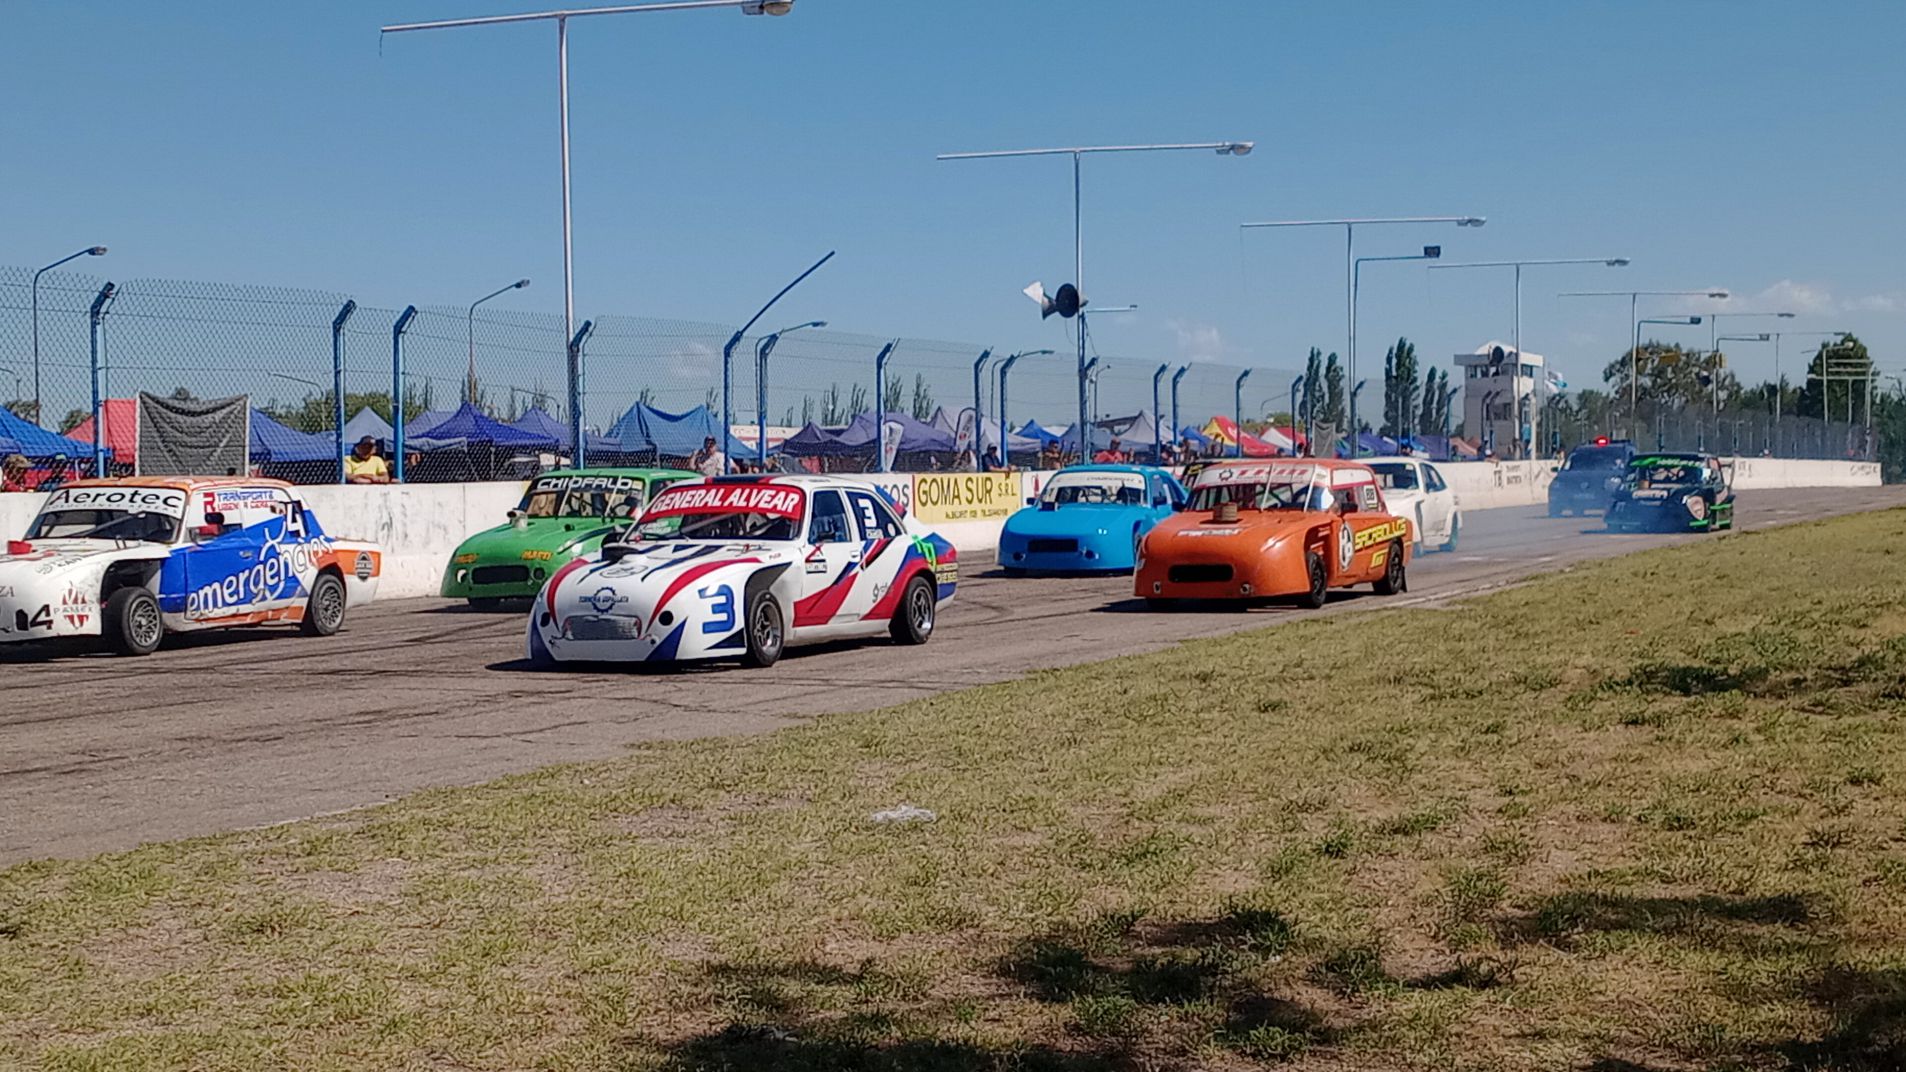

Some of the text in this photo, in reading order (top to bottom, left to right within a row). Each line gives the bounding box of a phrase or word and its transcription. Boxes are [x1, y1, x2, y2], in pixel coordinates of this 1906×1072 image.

[49, 490, 183, 508] Aerotec
[536, 478, 633, 490] CHIOFALO
[917, 476, 962, 507] GOMA
[965, 476, 993, 504] SUR
[650, 488, 801, 514] GENERAL ALVEAR
[857, 498, 877, 527] 3
[286, 501, 306, 538] 4
[186, 533, 334, 617] emergencias
[697, 584, 736, 634] 3
